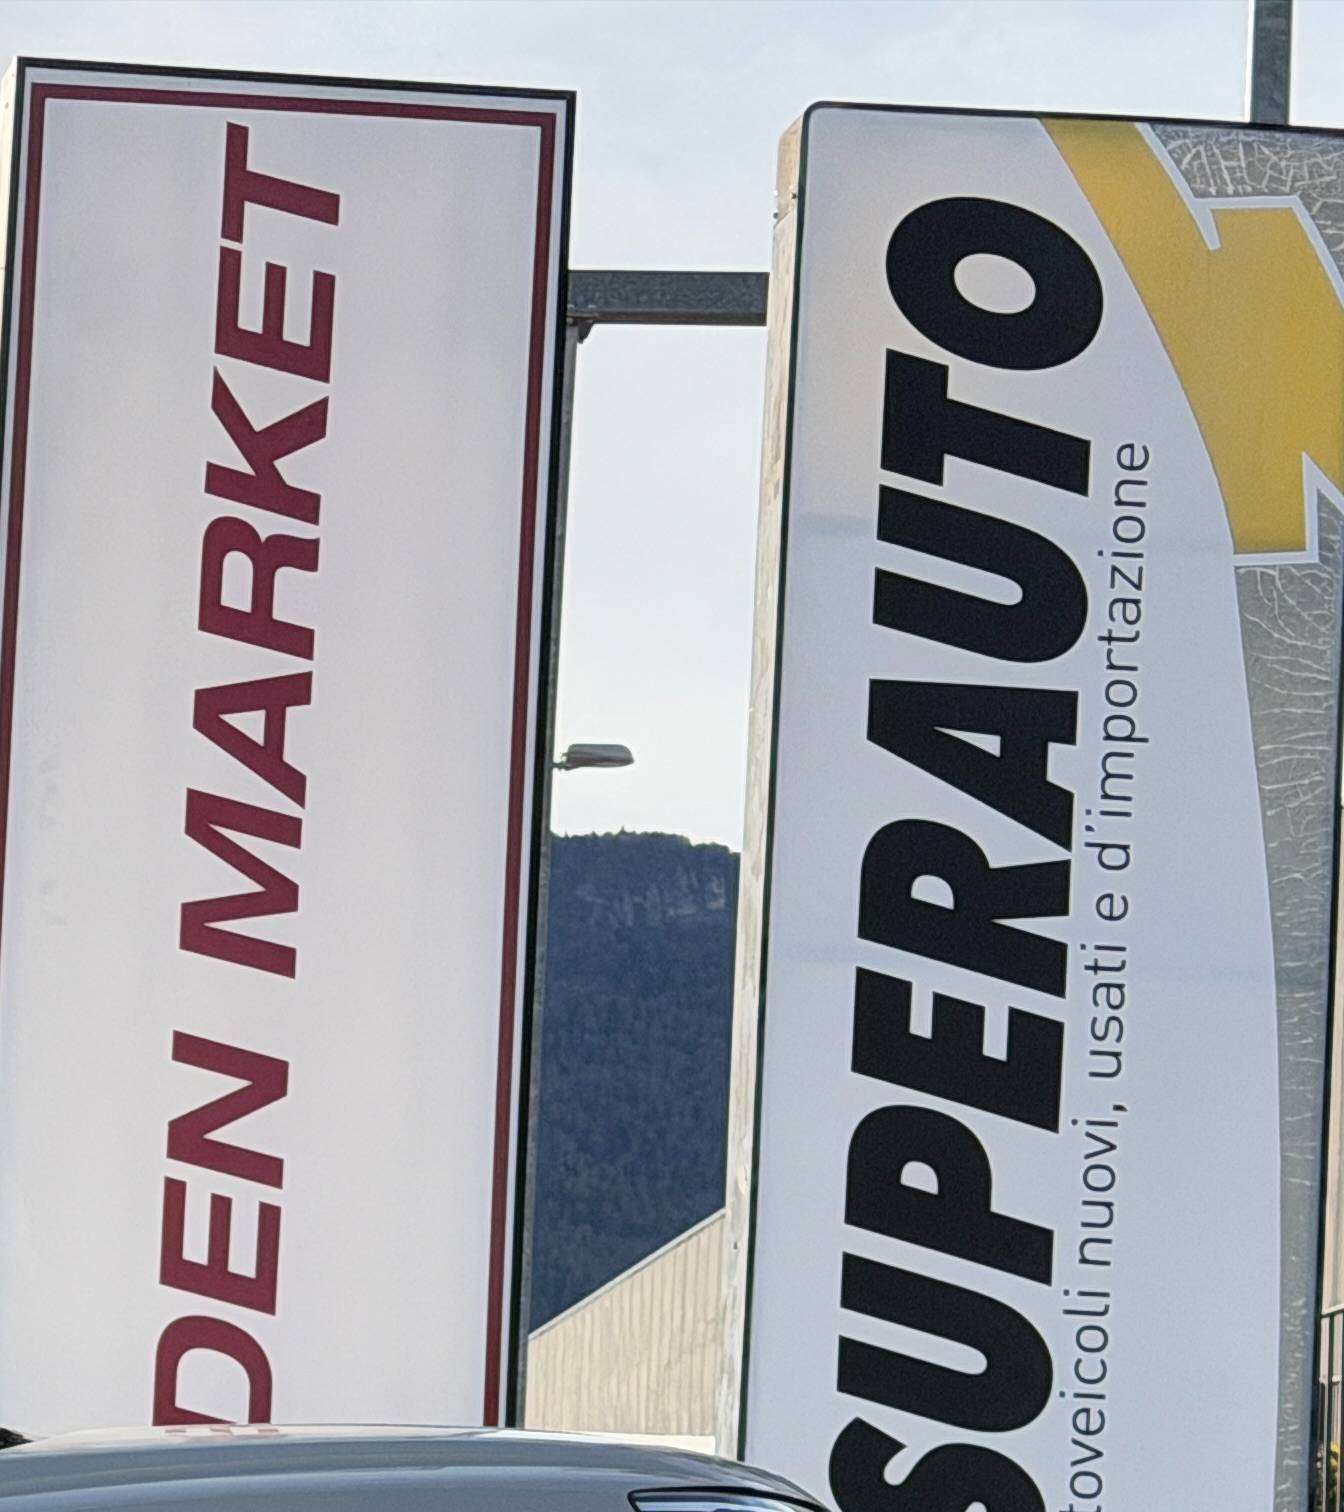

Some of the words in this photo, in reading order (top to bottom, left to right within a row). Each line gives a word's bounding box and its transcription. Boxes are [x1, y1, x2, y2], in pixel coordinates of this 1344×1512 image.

[179, 121, 341, 979] MARKET
[1084, 442, 1150, 871] d'importazione
[1095, 892, 1129, 923] e
[1081, 942, 1127, 1079] usati
[1070, 1102, 1127, 1267] nuovi,
